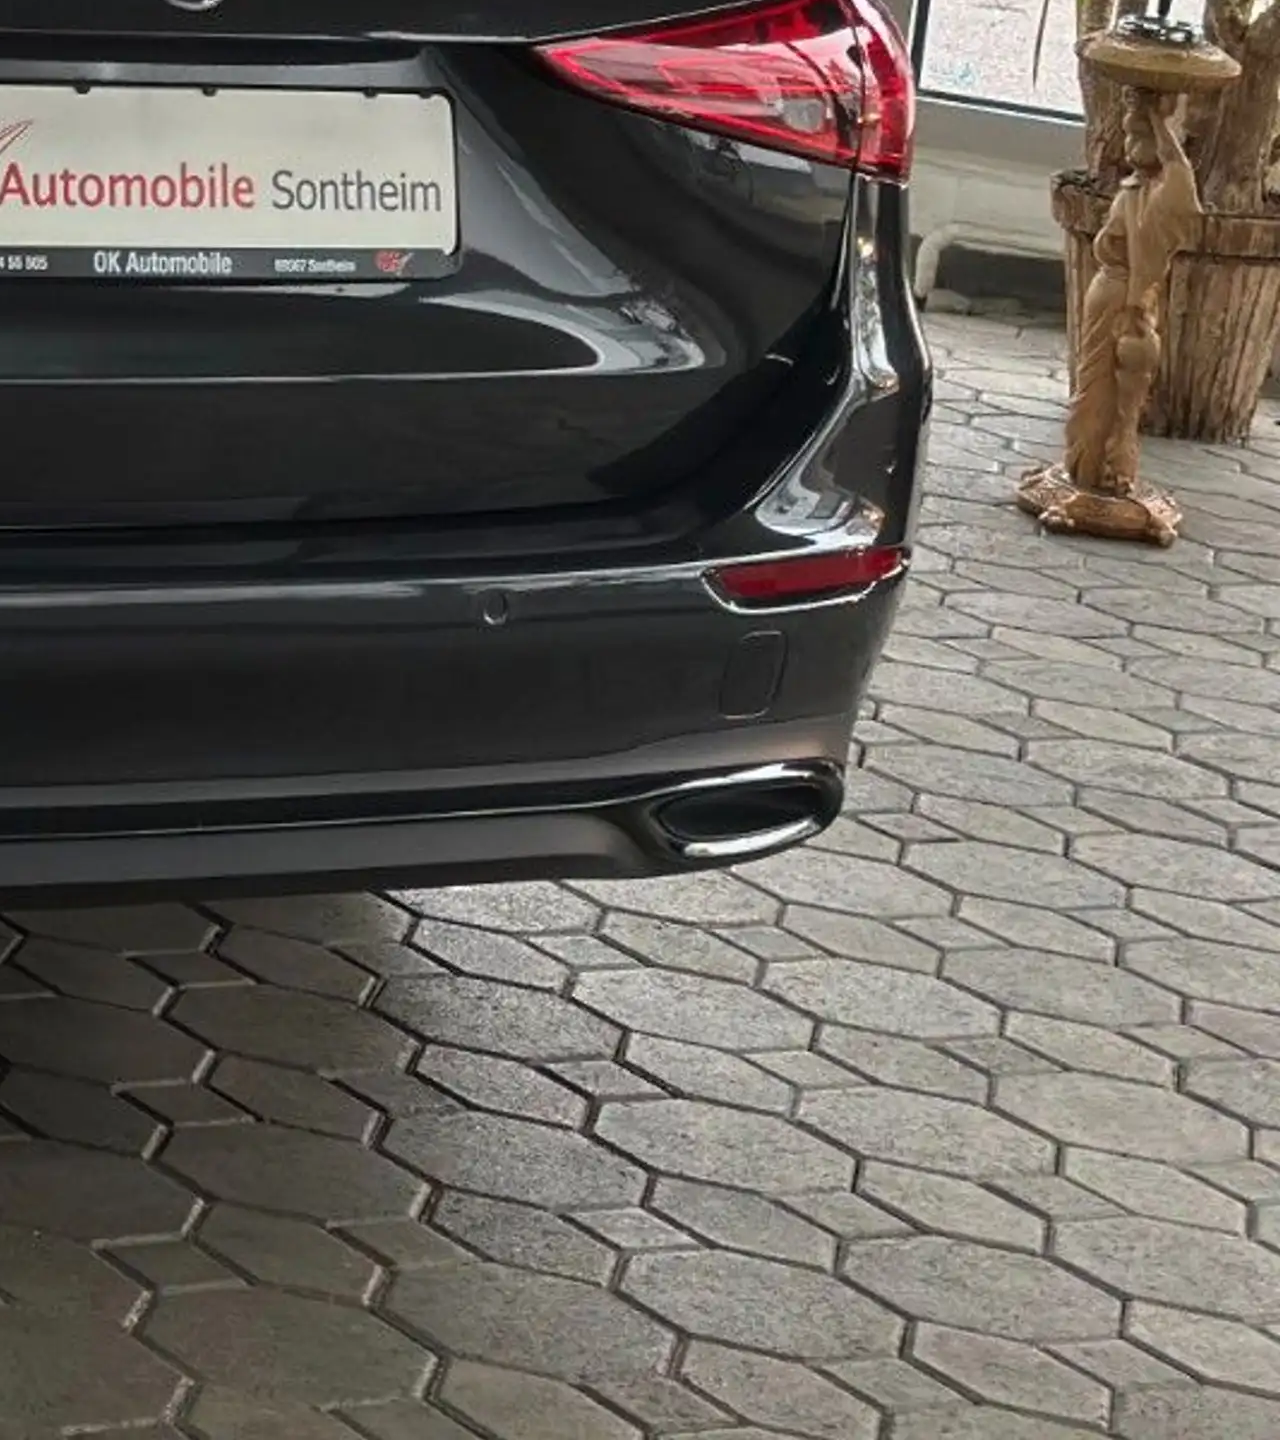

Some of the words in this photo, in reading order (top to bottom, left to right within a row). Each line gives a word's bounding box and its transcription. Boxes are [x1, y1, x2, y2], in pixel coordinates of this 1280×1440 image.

[272, 170, 441, 211] Sontheim
[93, 251, 120, 273] OK
[125, 252, 233, 274] Automobile
